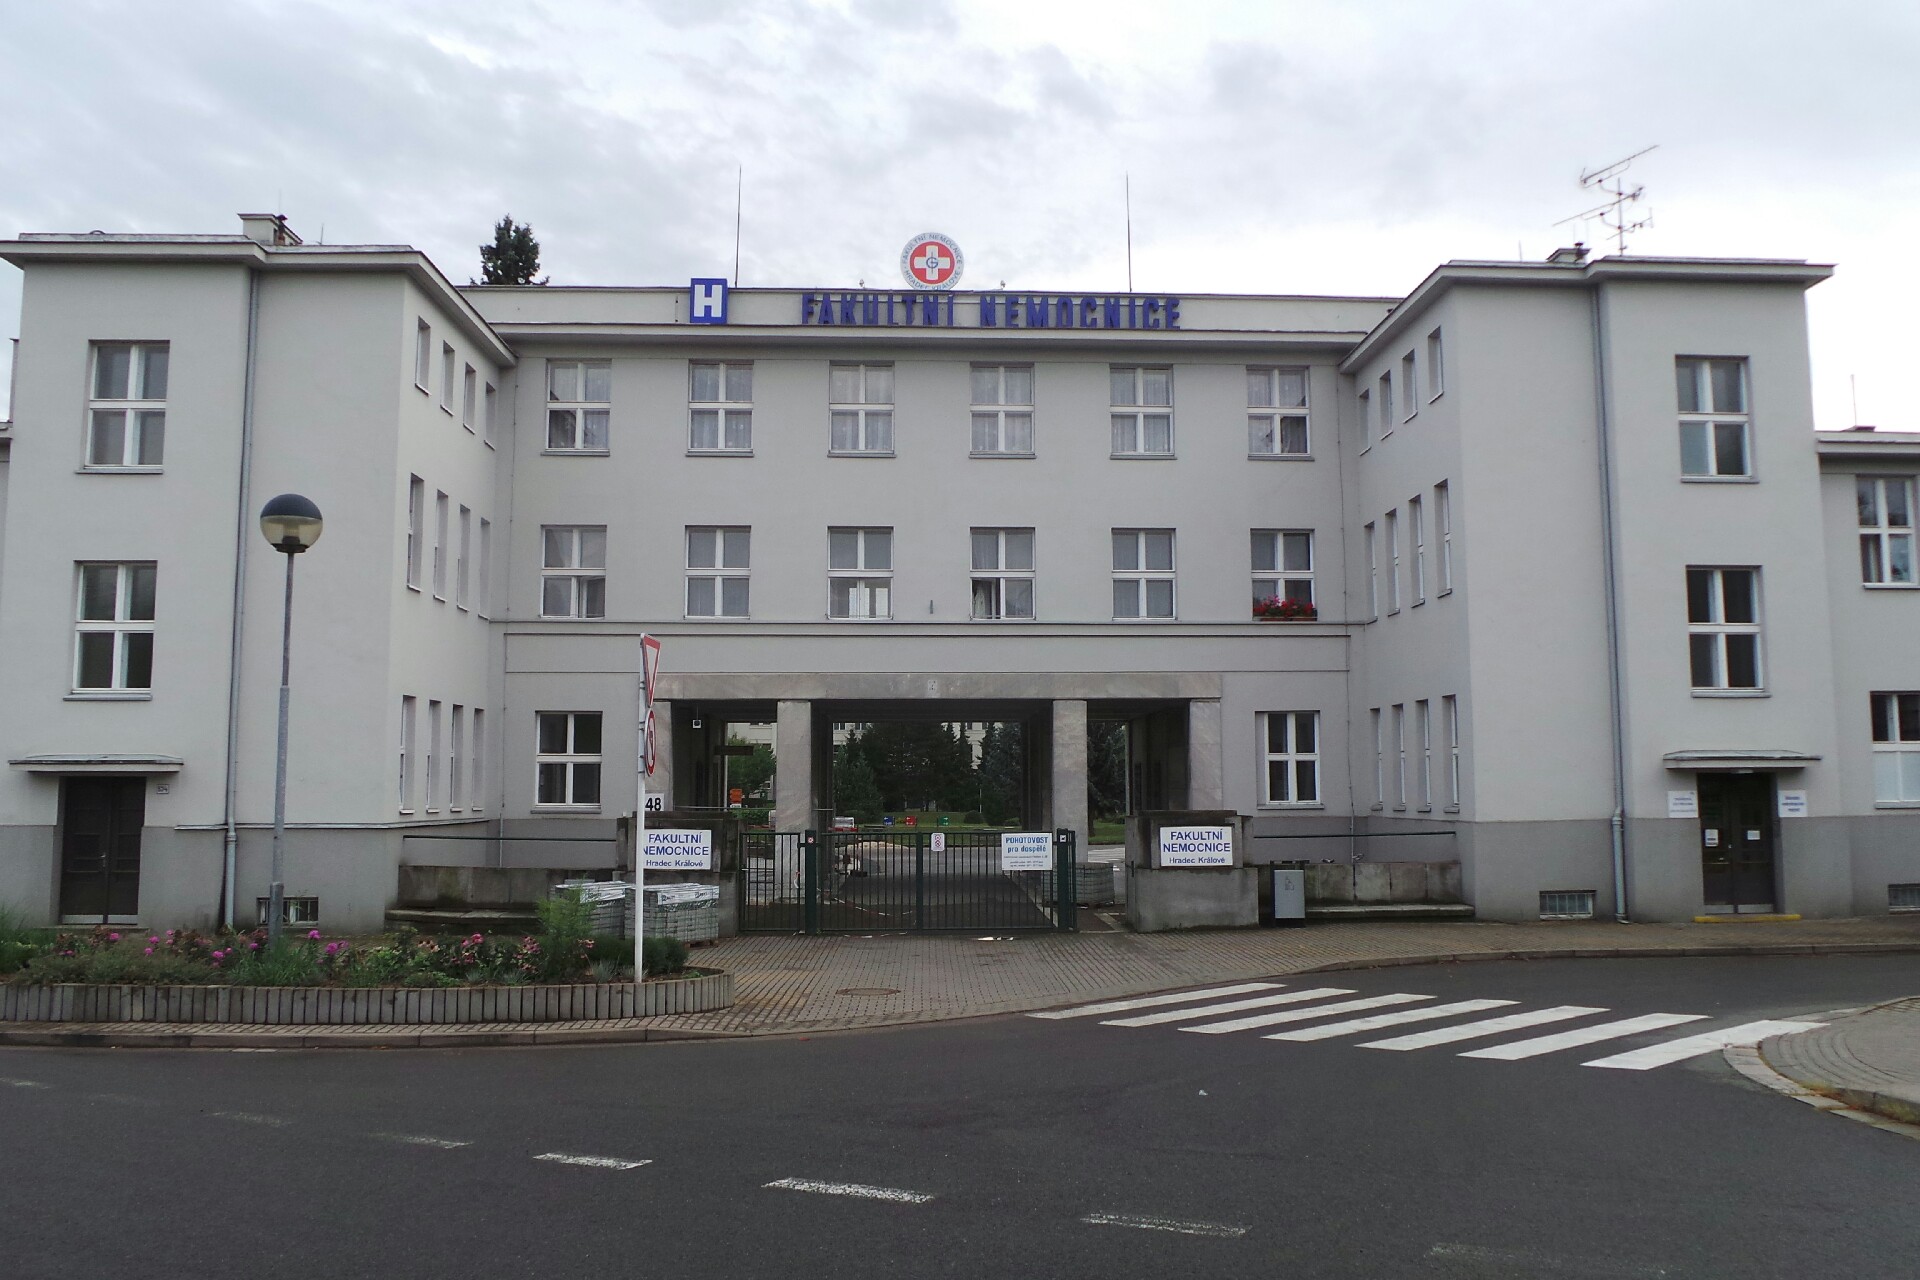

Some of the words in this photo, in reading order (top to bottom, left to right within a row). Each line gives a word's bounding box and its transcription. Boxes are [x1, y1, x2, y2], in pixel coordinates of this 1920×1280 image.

[693, 284, 723, 318] H
[979, 294, 1181, 330] NEMOCNICE
[645, 797, 662, 811] 48
[648, 832, 703, 844] FAKULTNÍ
[1005, 836, 1049, 844] POHOTOVOST
[1170, 828, 1223, 841] FAKULTNÍ
[1007, 846, 1019, 854] pro
[1020, 844, 1047, 853] dospělé
[1163, 842, 1231, 853] NEMOCNICE
[646, 859, 672, 867] Hradec
[674, 859, 704, 867] Králové
[1169, 856, 1196, 864] Hradec
[1198, 856, 1226, 864] Králové
